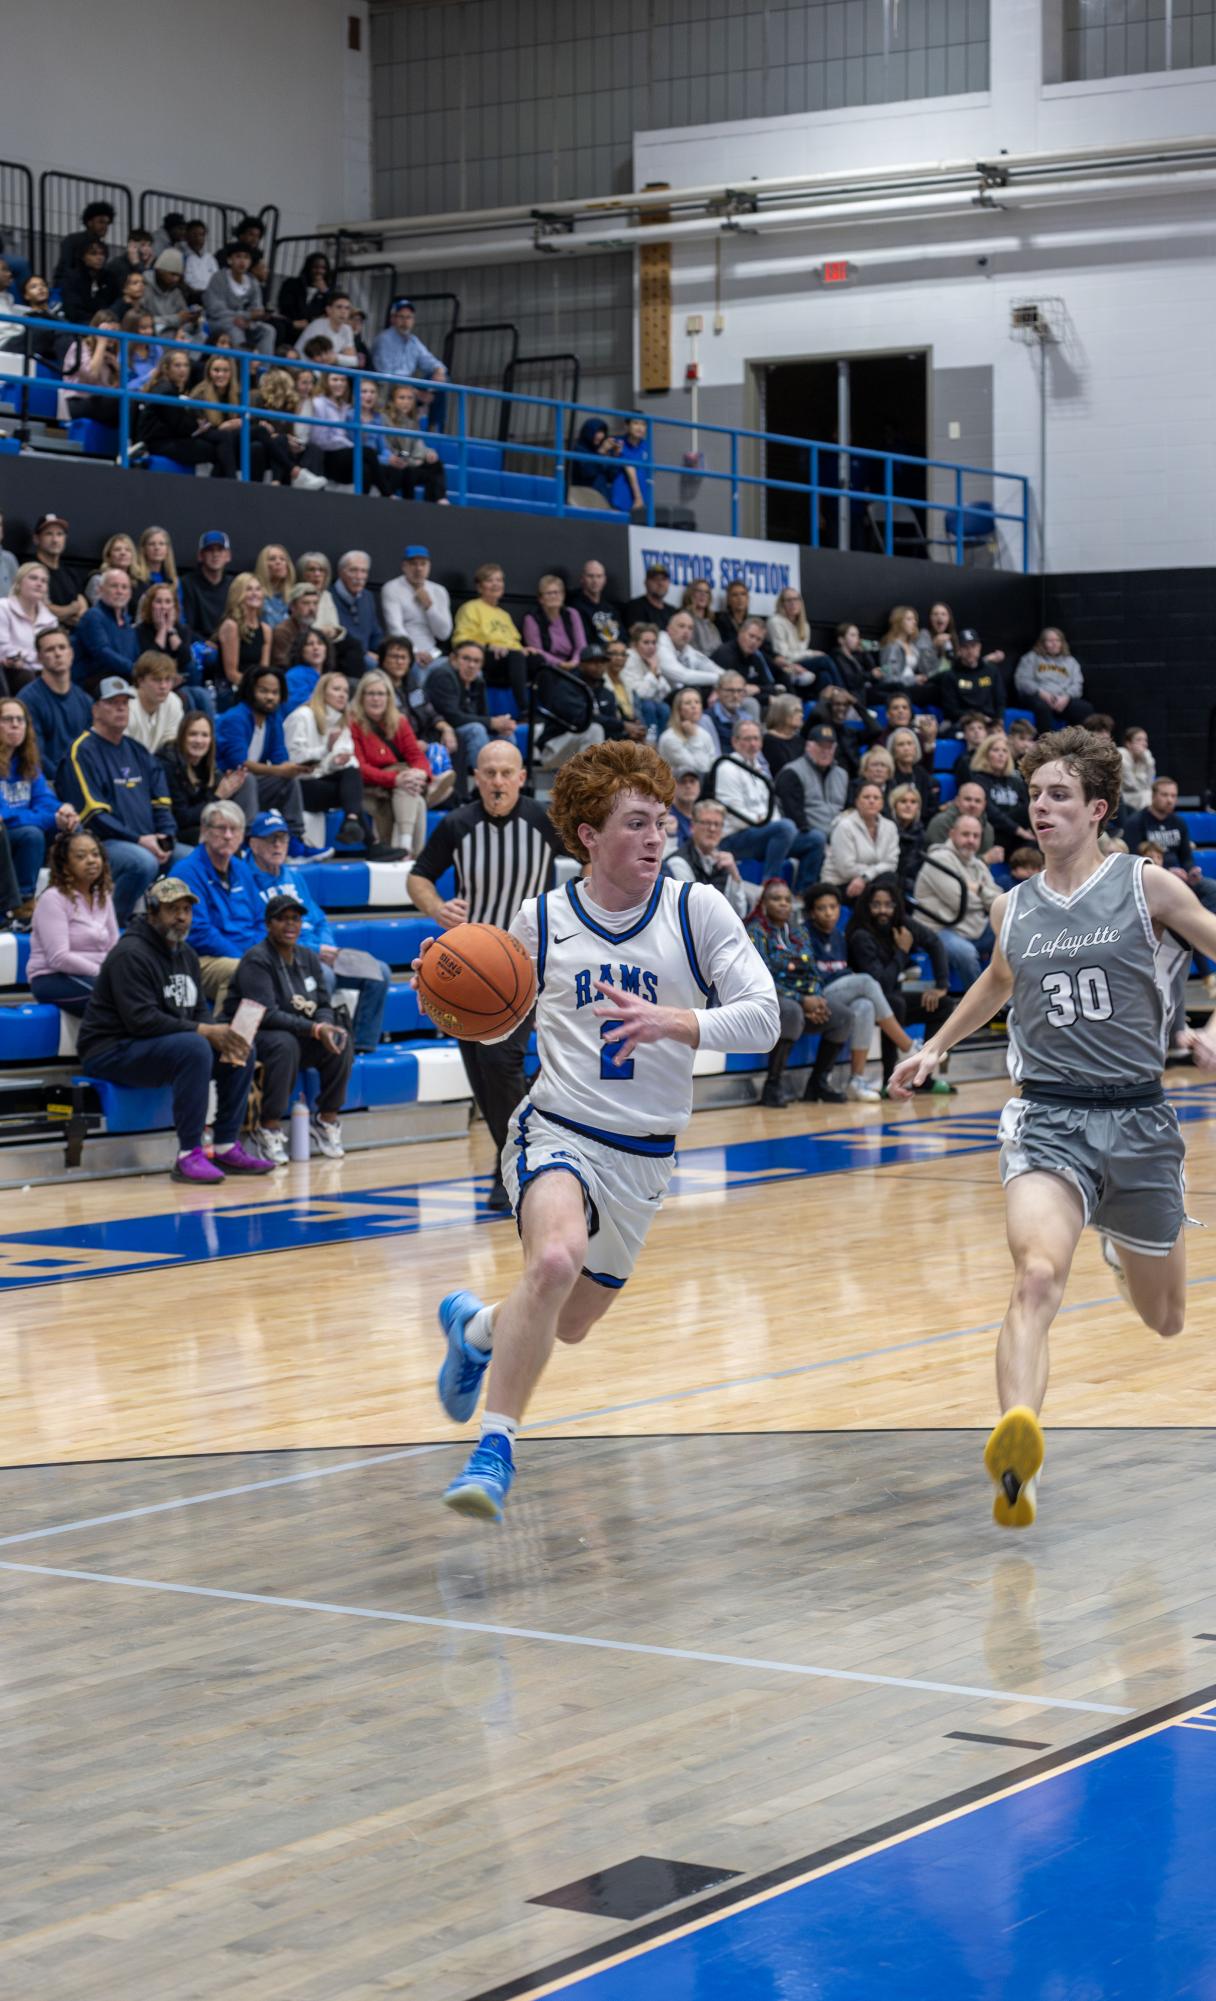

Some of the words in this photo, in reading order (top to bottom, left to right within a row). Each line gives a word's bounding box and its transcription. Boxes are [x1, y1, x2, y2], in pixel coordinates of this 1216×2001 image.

[641, 549, 716, 590] VISITOR
[719, 557, 790, 596] SECTION
[1021, 926, 1121, 959] Lafayette
[575, 963, 658, 1010] RAMS
[1041, 965, 1114, 1029] 30
[600, 1019, 635, 1081] 2
